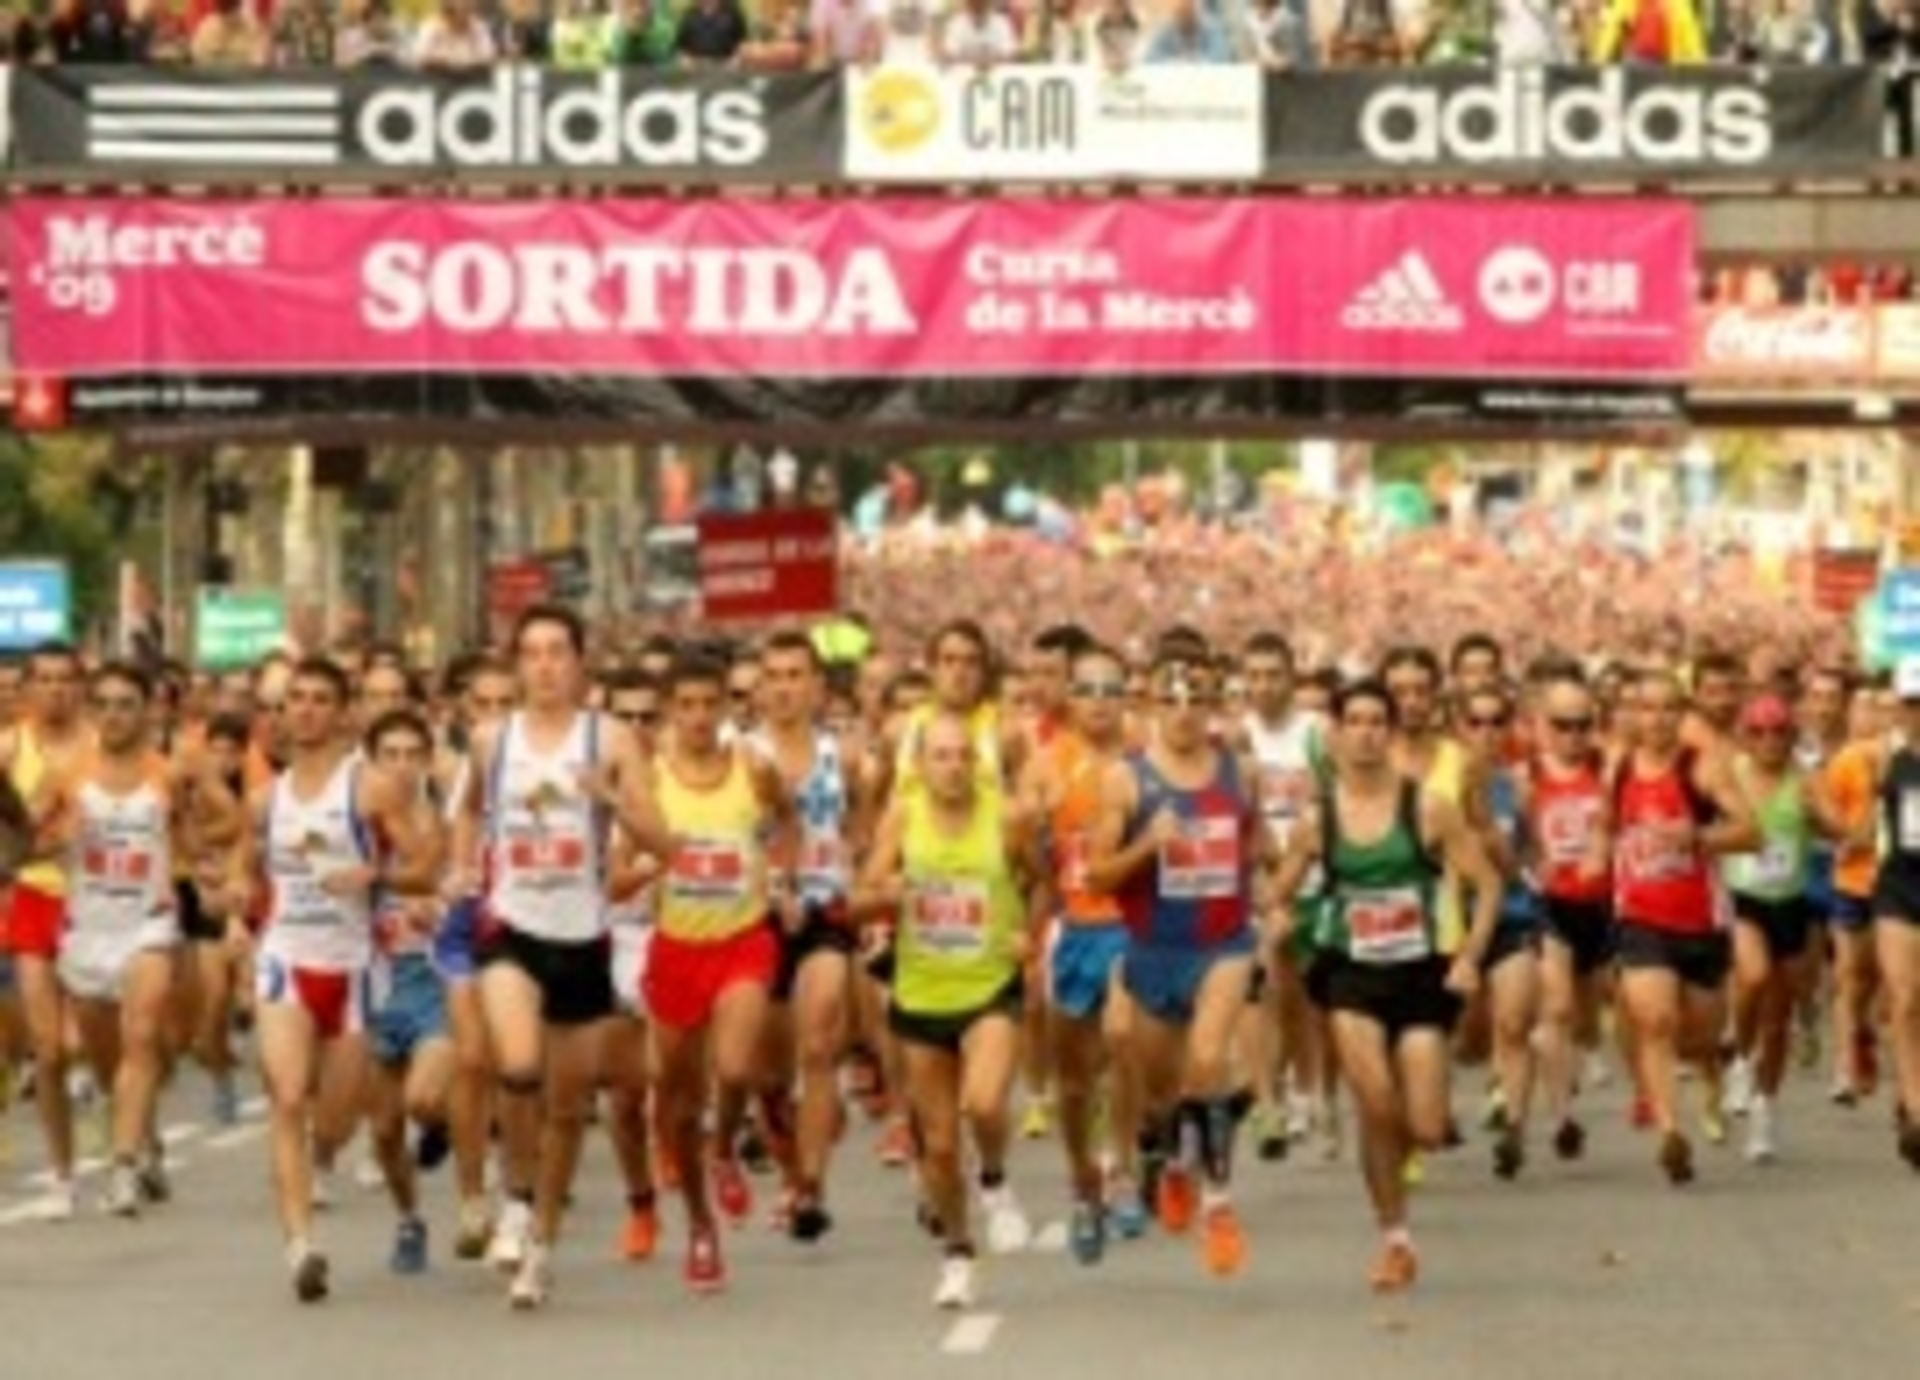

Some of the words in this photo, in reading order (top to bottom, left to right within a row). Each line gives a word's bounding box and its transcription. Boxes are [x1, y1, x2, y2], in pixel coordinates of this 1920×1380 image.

[357, 68, 770, 163] adidas
[963, 77, 1076, 151] CAM
[1360, 67, 1772, 162] adidas
[45, 216, 265, 266] Mercè
[965, 243, 1119, 284] Cursa
[360, 243, 918, 335] SORTIDA
[965, 296, 1028, 330] de
[1038, 293, 1090, 330] la
[1102, 287, 1256, 330] Mercè
